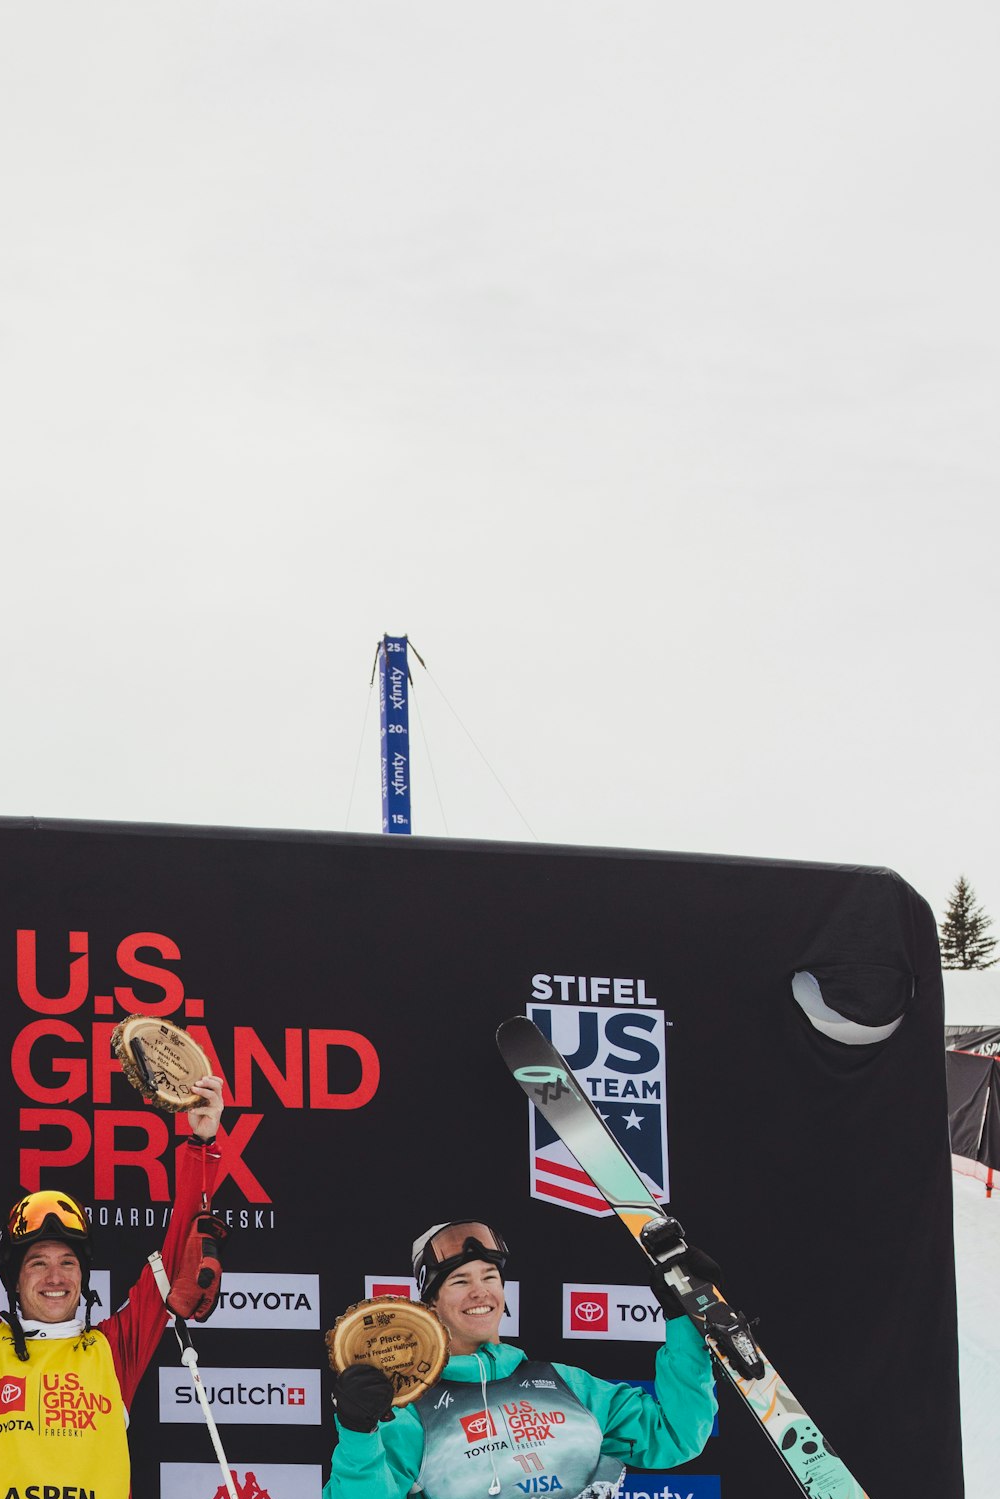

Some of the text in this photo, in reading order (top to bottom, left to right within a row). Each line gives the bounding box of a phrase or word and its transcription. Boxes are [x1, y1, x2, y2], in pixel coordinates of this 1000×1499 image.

[388, 666, 405, 710] xfinity
[391, 752, 407, 796] xfinity
[16, 929, 205, 1018] U.S.
[531, 973, 658, 1006] STIFEL
[531, 1008, 661, 1075] US
[156, 1056, 170, 1067] 2025
[163, 1044, 181, 1061] Place
[586, 1077, 662, 1100] TEAM
[219, 1292, 312, 1311] TOYOTA
[616, 1304, 666, 1323] TOY
[379, 1335, 401, 1345] Place
[380, 1355, 396, 1364] 2025
[43, 1372, 84, 1391] U.S.
[43, 1391, 112, 1415] GRAND
[503, 1400, 536, 1415] U.S.
[45, 1409, 97, 1431] PRIX
[508, 1411, 566, 1429] GRAND
[45, 1428, 83, 1438] FREESKI
[512, 1425, 556, 1443] PRIX
[463, 1441, 509, 1459] TOYOTA
[512, 1452, 545, 1473] 11
[512, 1475, 564, 1494] VISA
